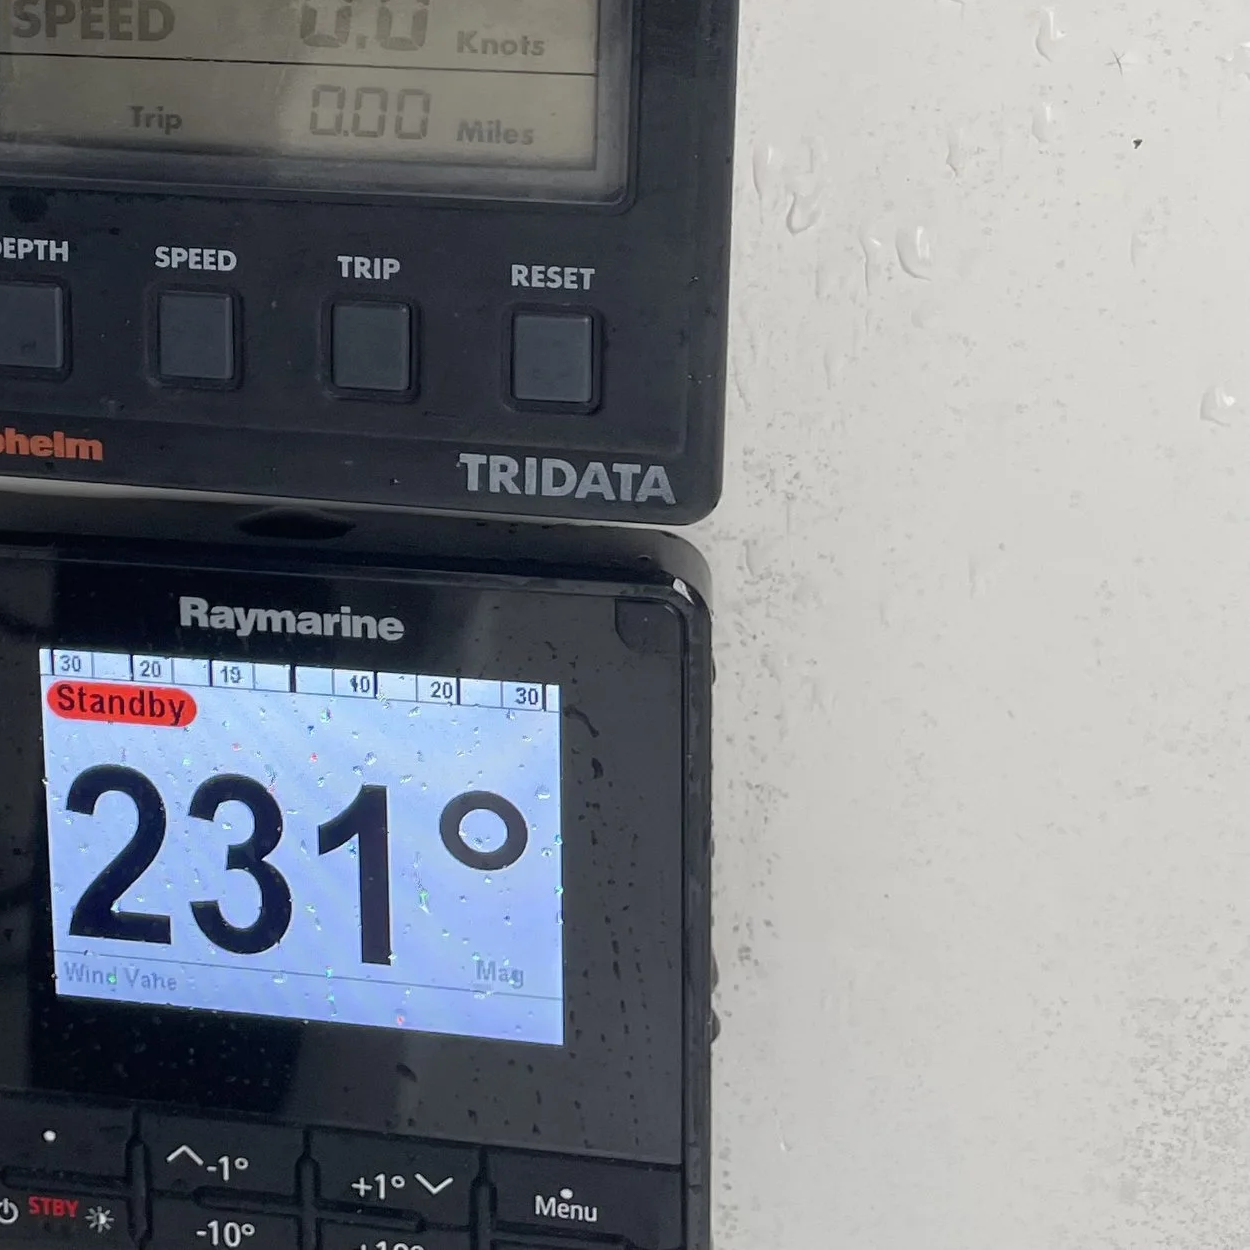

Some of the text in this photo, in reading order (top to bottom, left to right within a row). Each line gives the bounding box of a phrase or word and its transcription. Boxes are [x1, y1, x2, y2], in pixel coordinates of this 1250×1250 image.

[457, 30, 546, 59] Knots
[130, 85, 535, 147] Trip 0.00 Miles
[154, 246, 238, 273] SPEED
[336, 255, 402, 281] TRIP
[510, 264, 596, 291] RESET
[458, 452, 677, 506] TRIDATA
[178, 595, 406, 643] Raymarine
[60, 654, 82, 673] 30
[139, 660, 162, 679] 20
[430, 681, 453, 699] 20
[515, 687, 539, 705] 30
[56, 684, 185, 726] Standby
[64, 961, 118, 986] Wind
[475, 960, 525, 990] Mag
[29, 1196, 78, 1218] STBY
[535, 1195, 599, 1224] Menu
